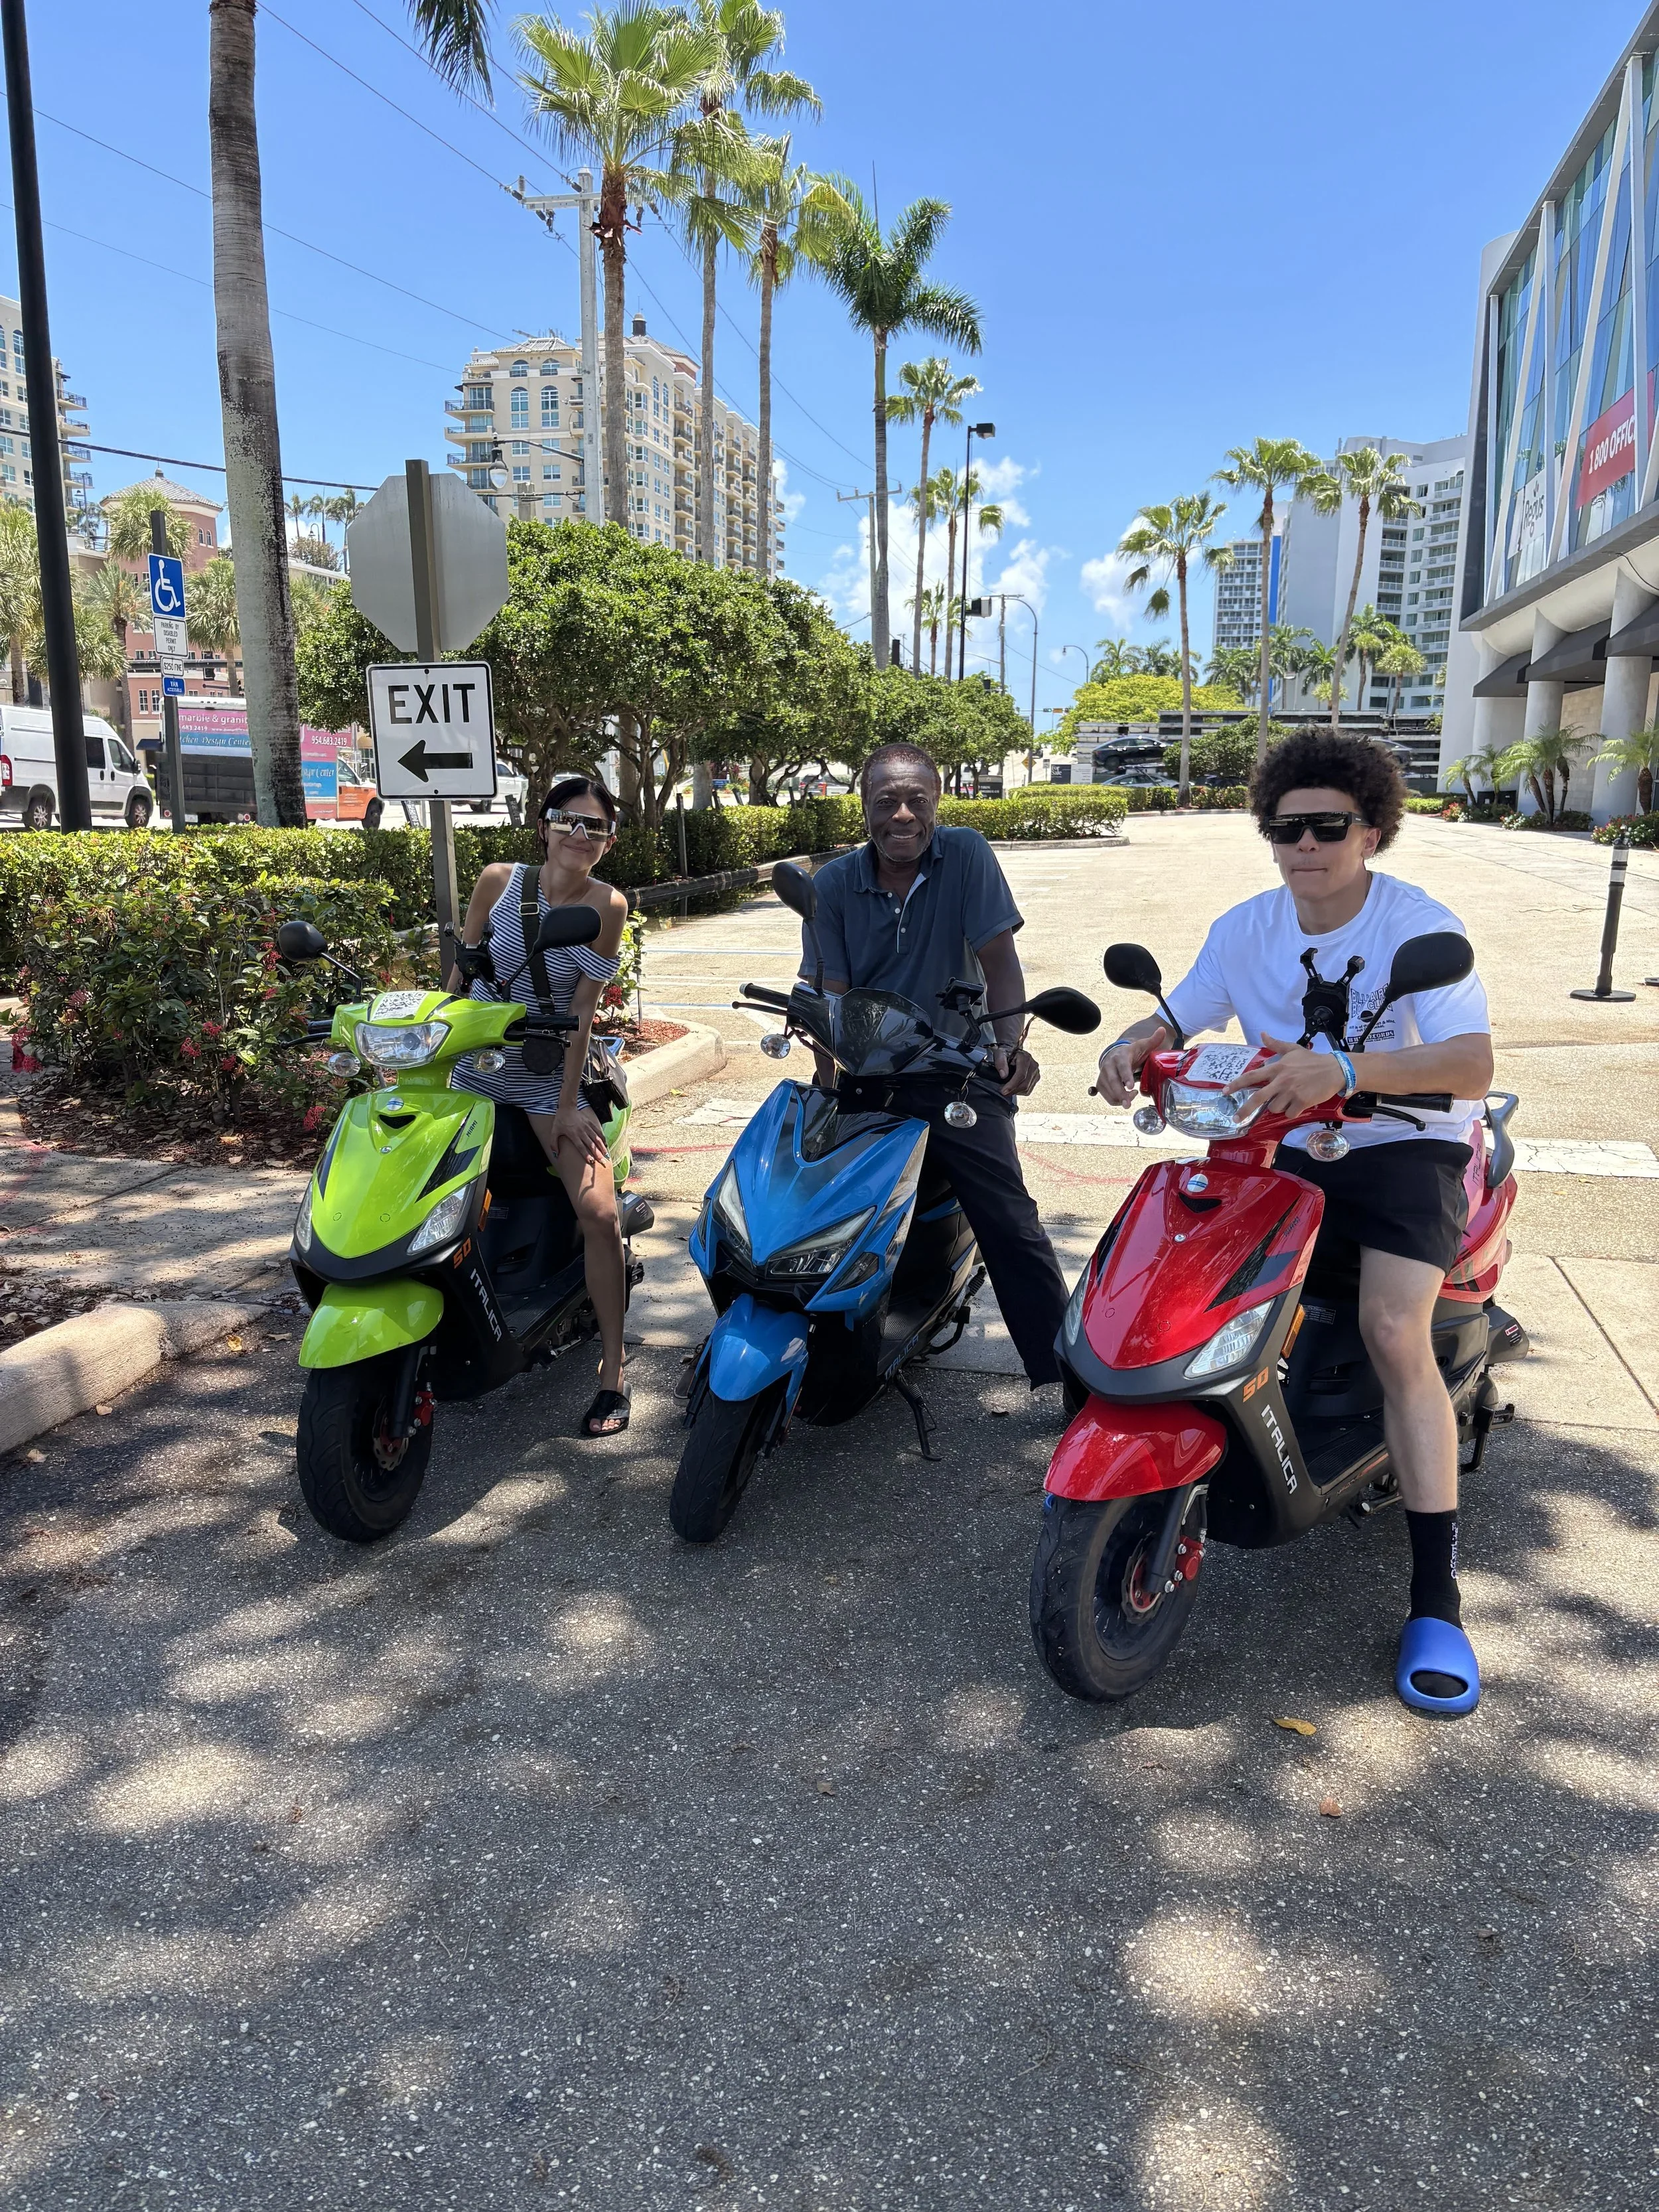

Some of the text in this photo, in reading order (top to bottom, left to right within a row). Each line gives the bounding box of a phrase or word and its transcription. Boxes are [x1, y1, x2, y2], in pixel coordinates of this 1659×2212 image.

[1589, 414, 1635, 475] 1 800 OFFIC
[1524, 494, 1544, 538] Regus
[164, 662, 173, 670] $250
[179, 713, 210, 722] marble
[212, 714, 218, 723] &
[388, 683, 475, 724] EXIT
[312, 735, 347, 745] 954.683.2419
[467, 1120, 478, 1137] MIAMI
[453, 1238, 472, 1269] 50
[470, 1268, 502, 1342] ITALICA
[885, 1334, 918, 1380] ITALICA
[1243, 1366, 1269, 1402] 50
[1261, 1404, 1297, 1494] ITALICA
